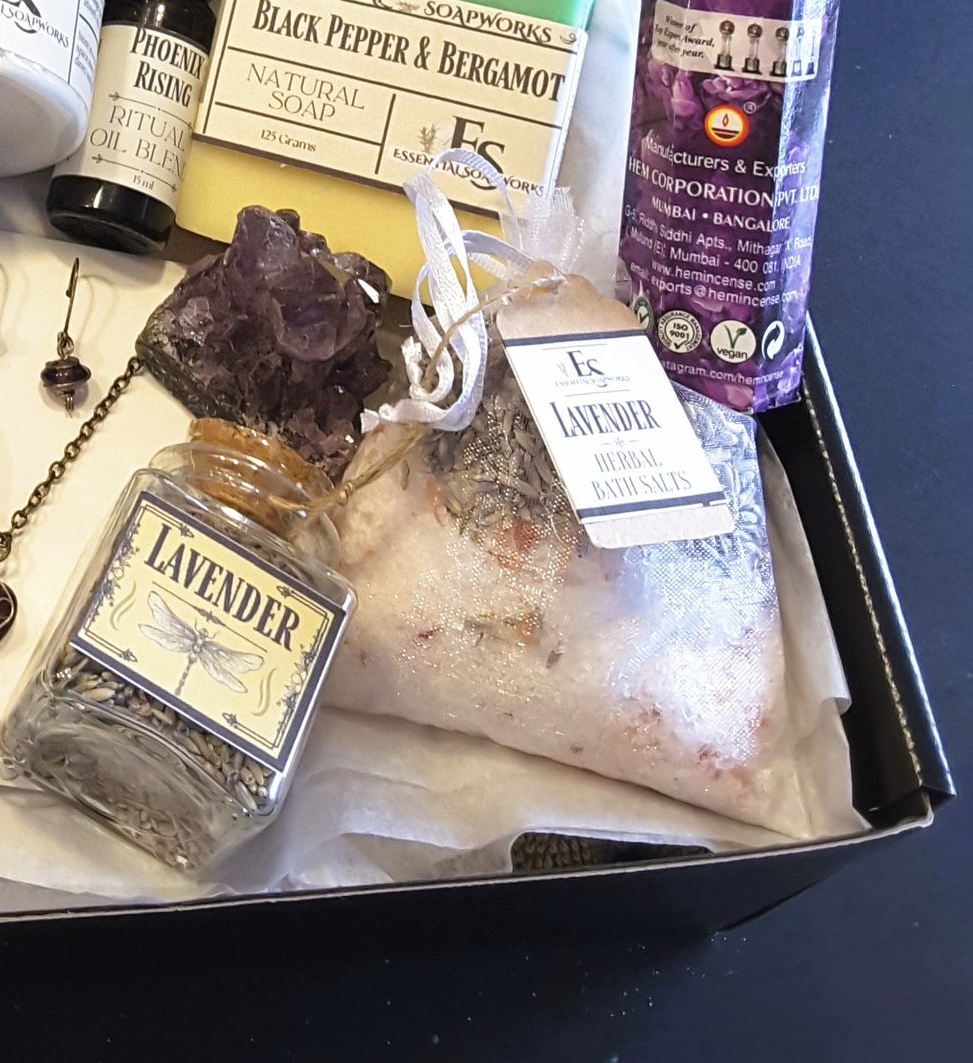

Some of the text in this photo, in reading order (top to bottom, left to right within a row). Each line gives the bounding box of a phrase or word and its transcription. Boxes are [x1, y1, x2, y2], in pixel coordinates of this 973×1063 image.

[424, 0, 552, 44] SOAPWORKS
[685, 23, 698, 33] of
[130, 28, 206, 80] PHOENIX
[324, 14, 409, 65] PEPPER
[414, 35, 432, 70] &
[437, 43, 565, 103] BERGAMOT
[133, 61, 193, 108] RISING
[246, 63, 365, 110] NATURAL
[268, 91, 337, 122] SOAP
[90, 128, 126, 153] OIL
[109, 105, 185, 152] RITUAL
[260, 129, 317, 154] 125 Grams
[643, 136, 806, 181] Manufacturers & Exporters
[628, 157, 649, 180] HEM
[651, 169, 774, 208] CORPORATION
[652, 196, 790, 232] MUMBAI BANGALORE
[659, 224, 692, 243] Siddhi
[737, 239, 782, 258] Mithagar
[651, 258, 776, 292] www.hemincense.com
[670, 247, 720, 267] Mumbai
[734, 259, 758, 273] 400
[651, 275, 799, 308] exports@hemincense.com
[669, 329, 690, 341] 9001
[673, 322, 688, 331] ISO
[717, 348, 748, 360] vegan
[549, 399, 662, 438] LAVENDER
[594, 448, 663, 473] HERBAL
[591, 470, 692, 501] BATH SALTS
[144, 522, 300, 652] LAVENDER
